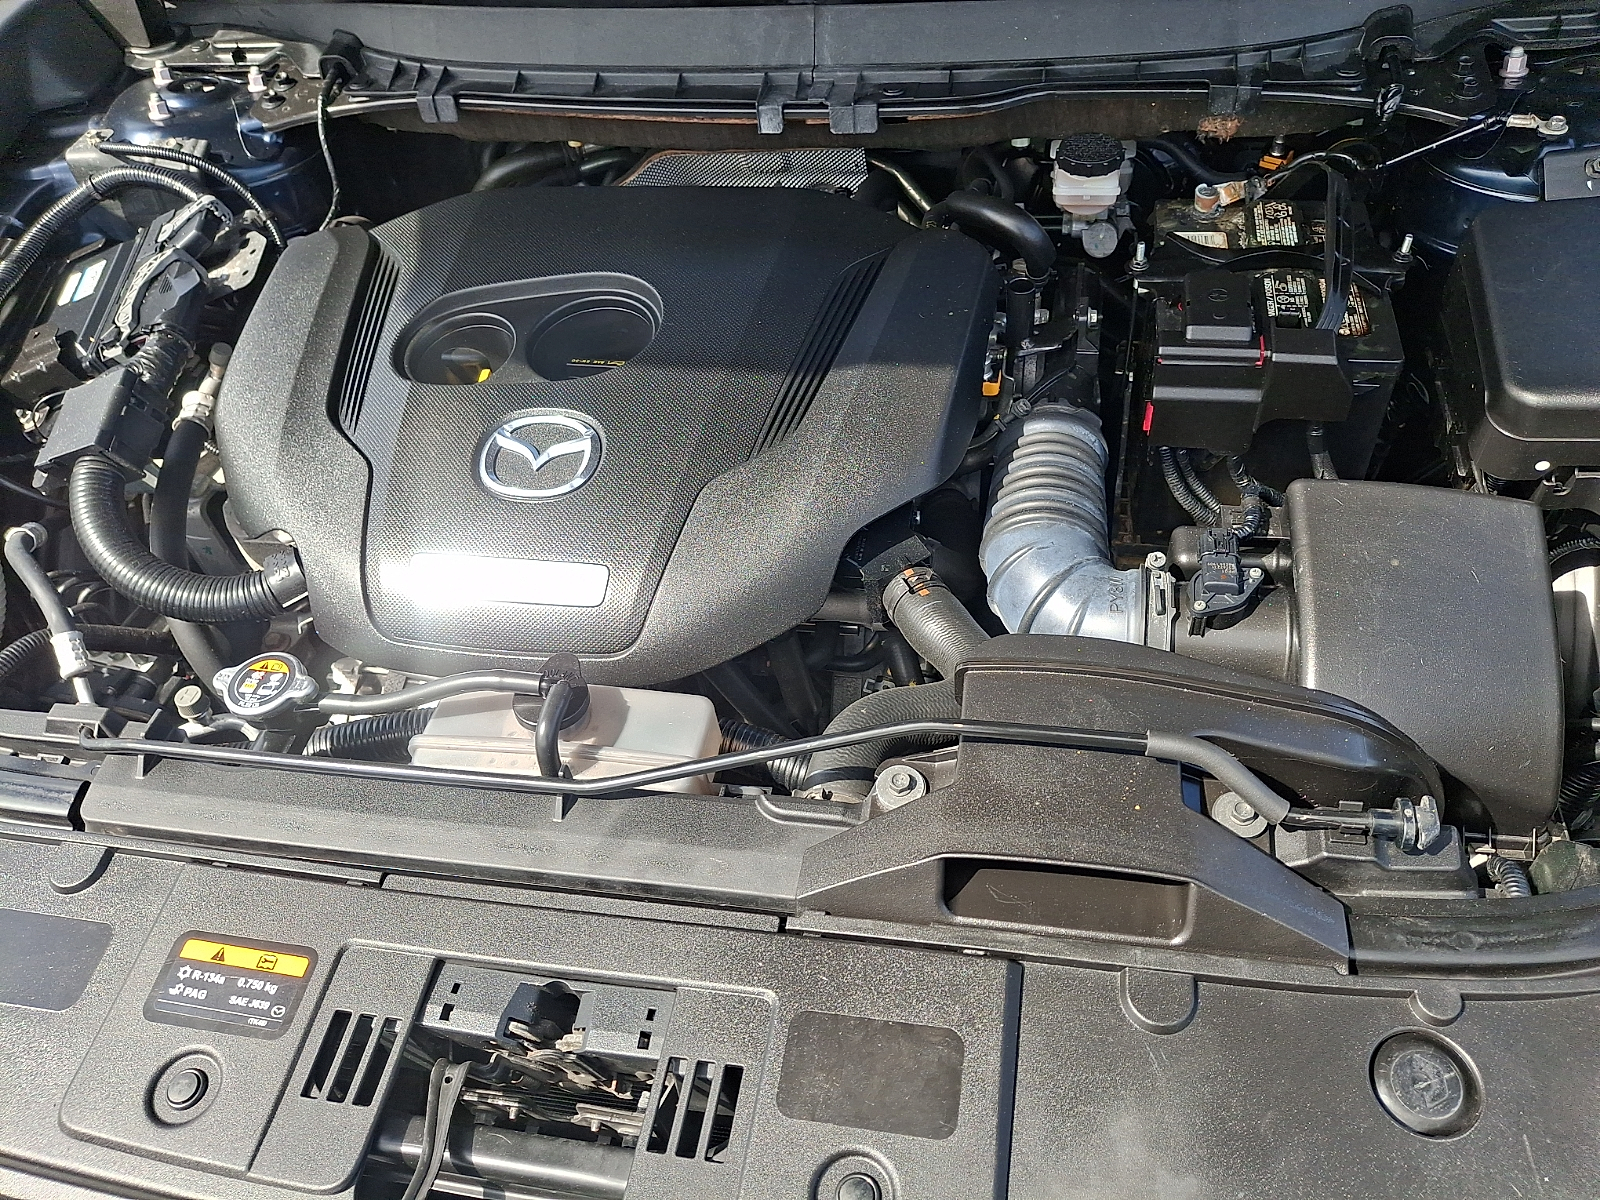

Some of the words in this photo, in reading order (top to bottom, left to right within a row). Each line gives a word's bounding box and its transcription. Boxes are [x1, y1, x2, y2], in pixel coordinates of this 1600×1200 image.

[1263, 278, 1273, 297] POISON
[192, 970, 226, 985] R-134a
[237, 977, 264, 990] 0.750
[264, 981, 278, 995] kg
[183, 987, 207, 1000] PAG
[229, 995, 249, 1007] SAE
